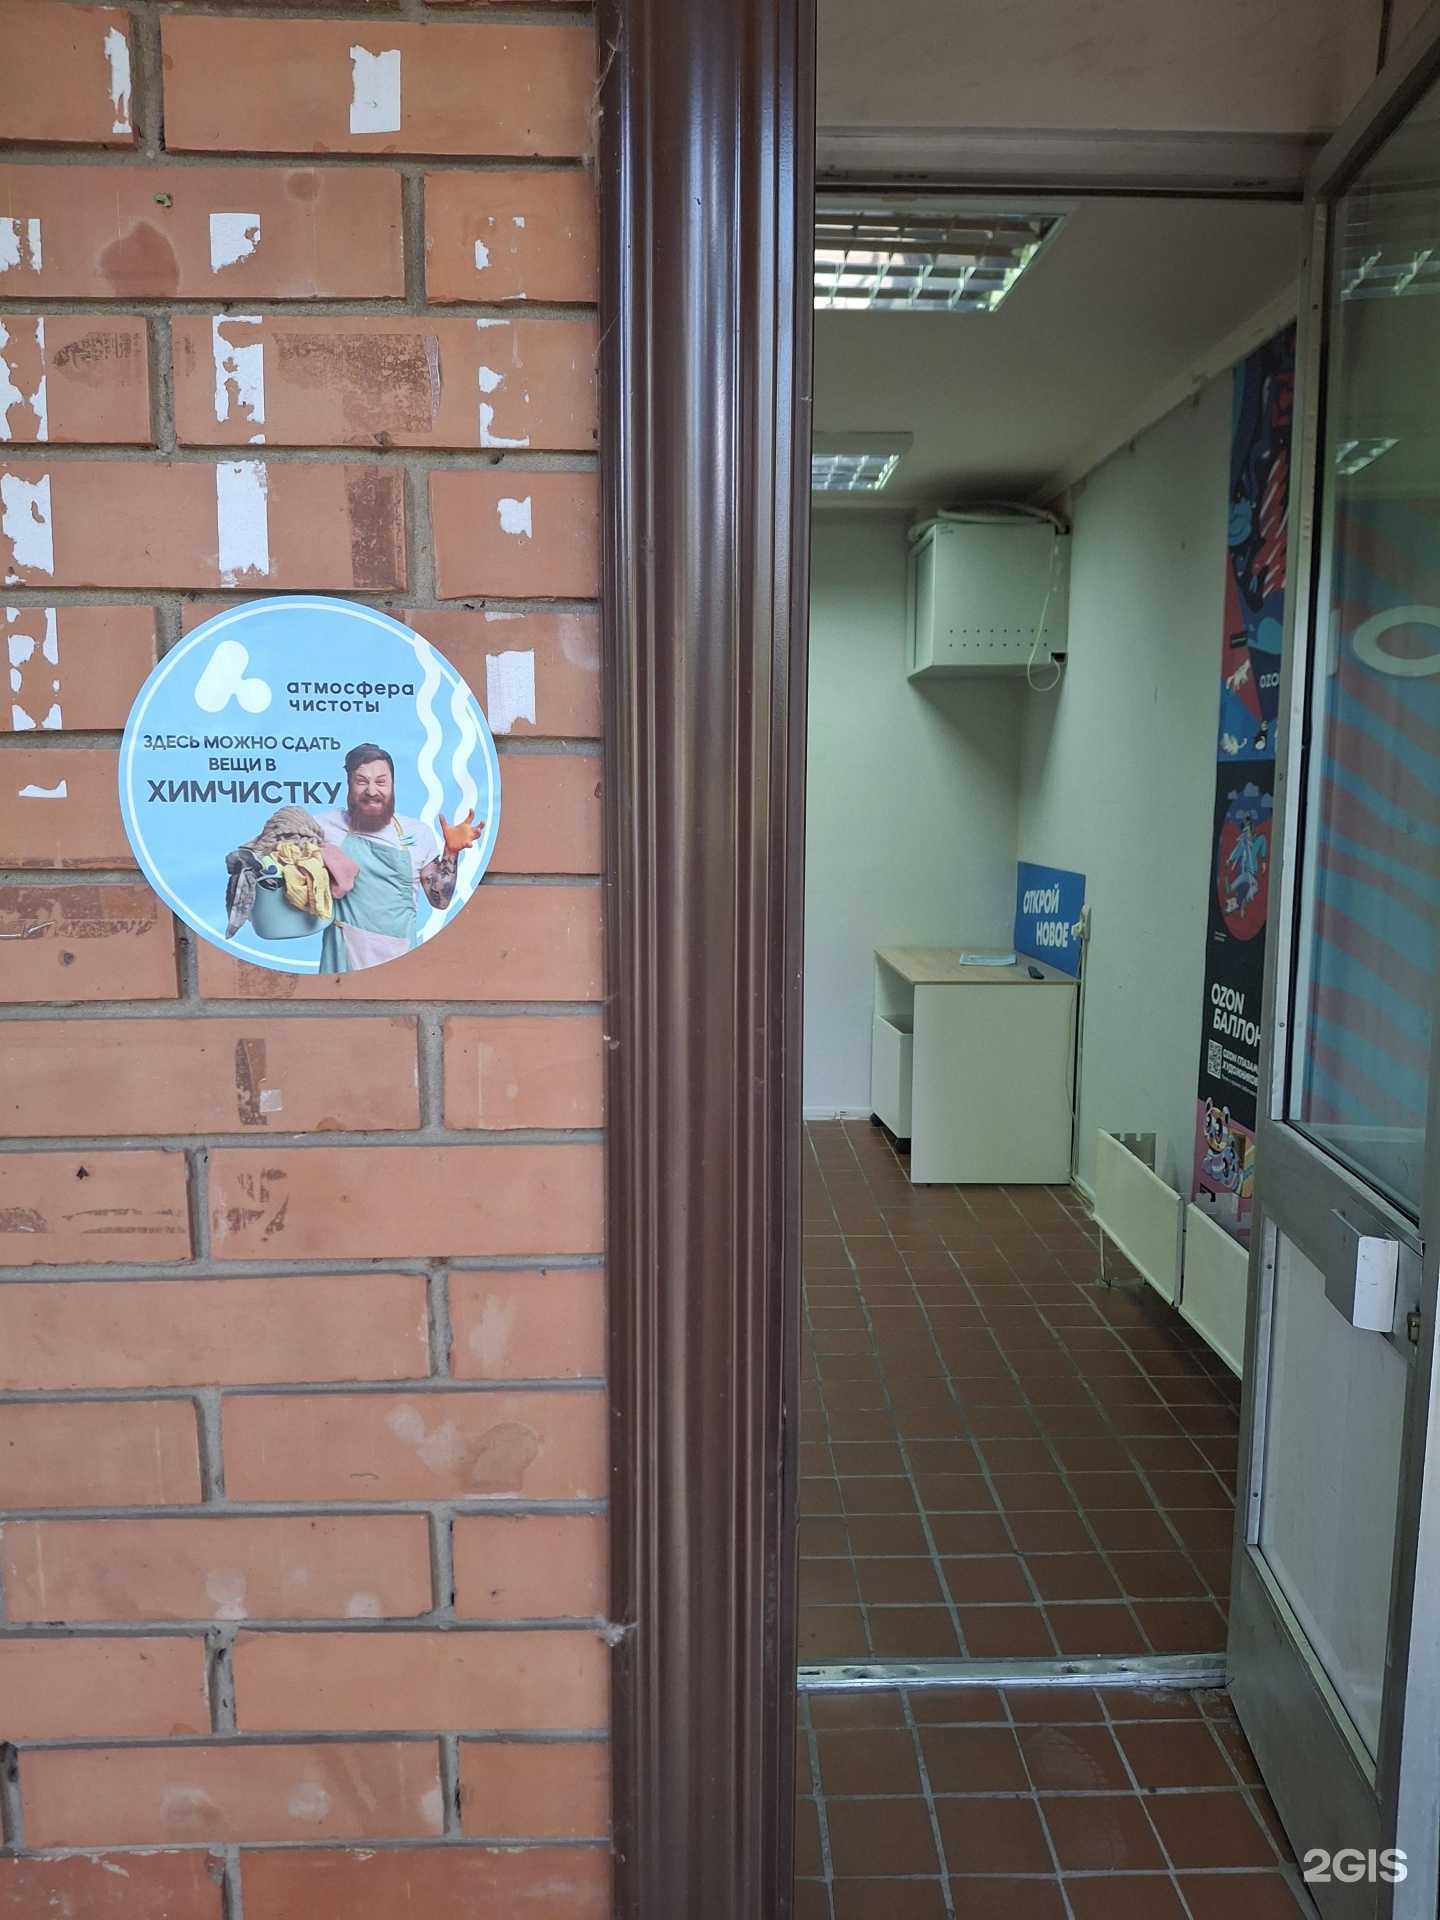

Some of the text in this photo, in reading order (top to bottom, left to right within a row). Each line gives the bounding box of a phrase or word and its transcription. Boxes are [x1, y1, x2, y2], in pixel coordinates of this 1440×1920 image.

[286, 680, 414, 699] атмосфера
[143, 734, 341, 752] ЗДЕСЬ МОЖНО СДАТЬ
[208, 757, 277, 773] ВЕЩИ В
[147, 780, 342, 804] ХИМЧИСТКУ
[1023, 883, 1059, 914] ОТКРОЙ
[1036, 921, 1069, 948] НОВОЕ
[1211, 983, 1245, 1015] OZON
